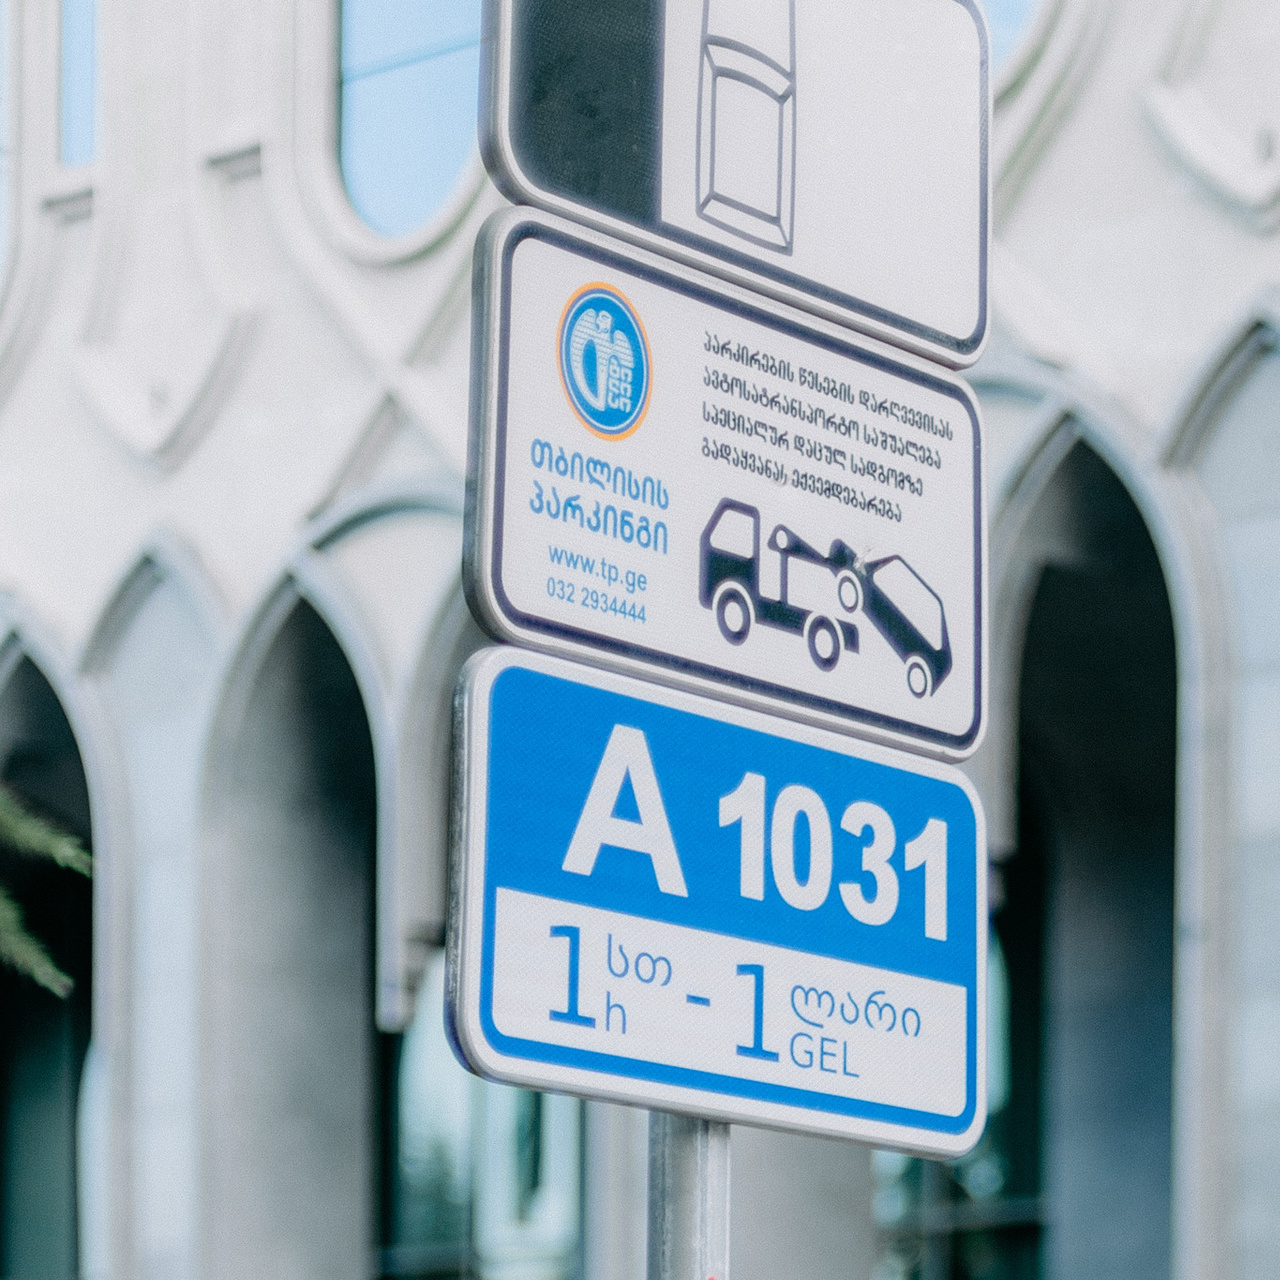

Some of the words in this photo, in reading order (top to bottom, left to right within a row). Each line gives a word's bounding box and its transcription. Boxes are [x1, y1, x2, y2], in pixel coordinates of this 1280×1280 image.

[703, 331, 795, 382] პარკირების
[799, 367, 854, 405] წესების
[859, 390, 953, 441] დარღვევისას
[703, 366, 859, 441] ავტოსატრანსპორტო
[863, 424, 941, 469] საშუალება
[531, 438, 669, 510] თბილისის
[702, 401, 789, 450] სპეციალურ
[794, 434, 846, 470] დაცულ
[851, 453, 923, 496] სადგომზე
[702, 437, 788, 485] გადაყვანას
[792, 469, 902, 522] ექვემდებარება
[529, 479, 668, 555] პარკინგი
[547, 577, 575, 604] 032
[581, 587, 647, 623] 2934444
[549, 545, 648, 594] www.tp.ge
[561, 723, 689, 898] A
[718, 771, 948, 942] 1031
[549, 925, 597, 1029] 1
[606, 932, 673, 986] სთ
[736, 963, 779, 1063] 1
[790, 983, 921, 1037] ლარი
[605, 991, 627, 1035] h
[789, 1033, 860, 1078] GEL
